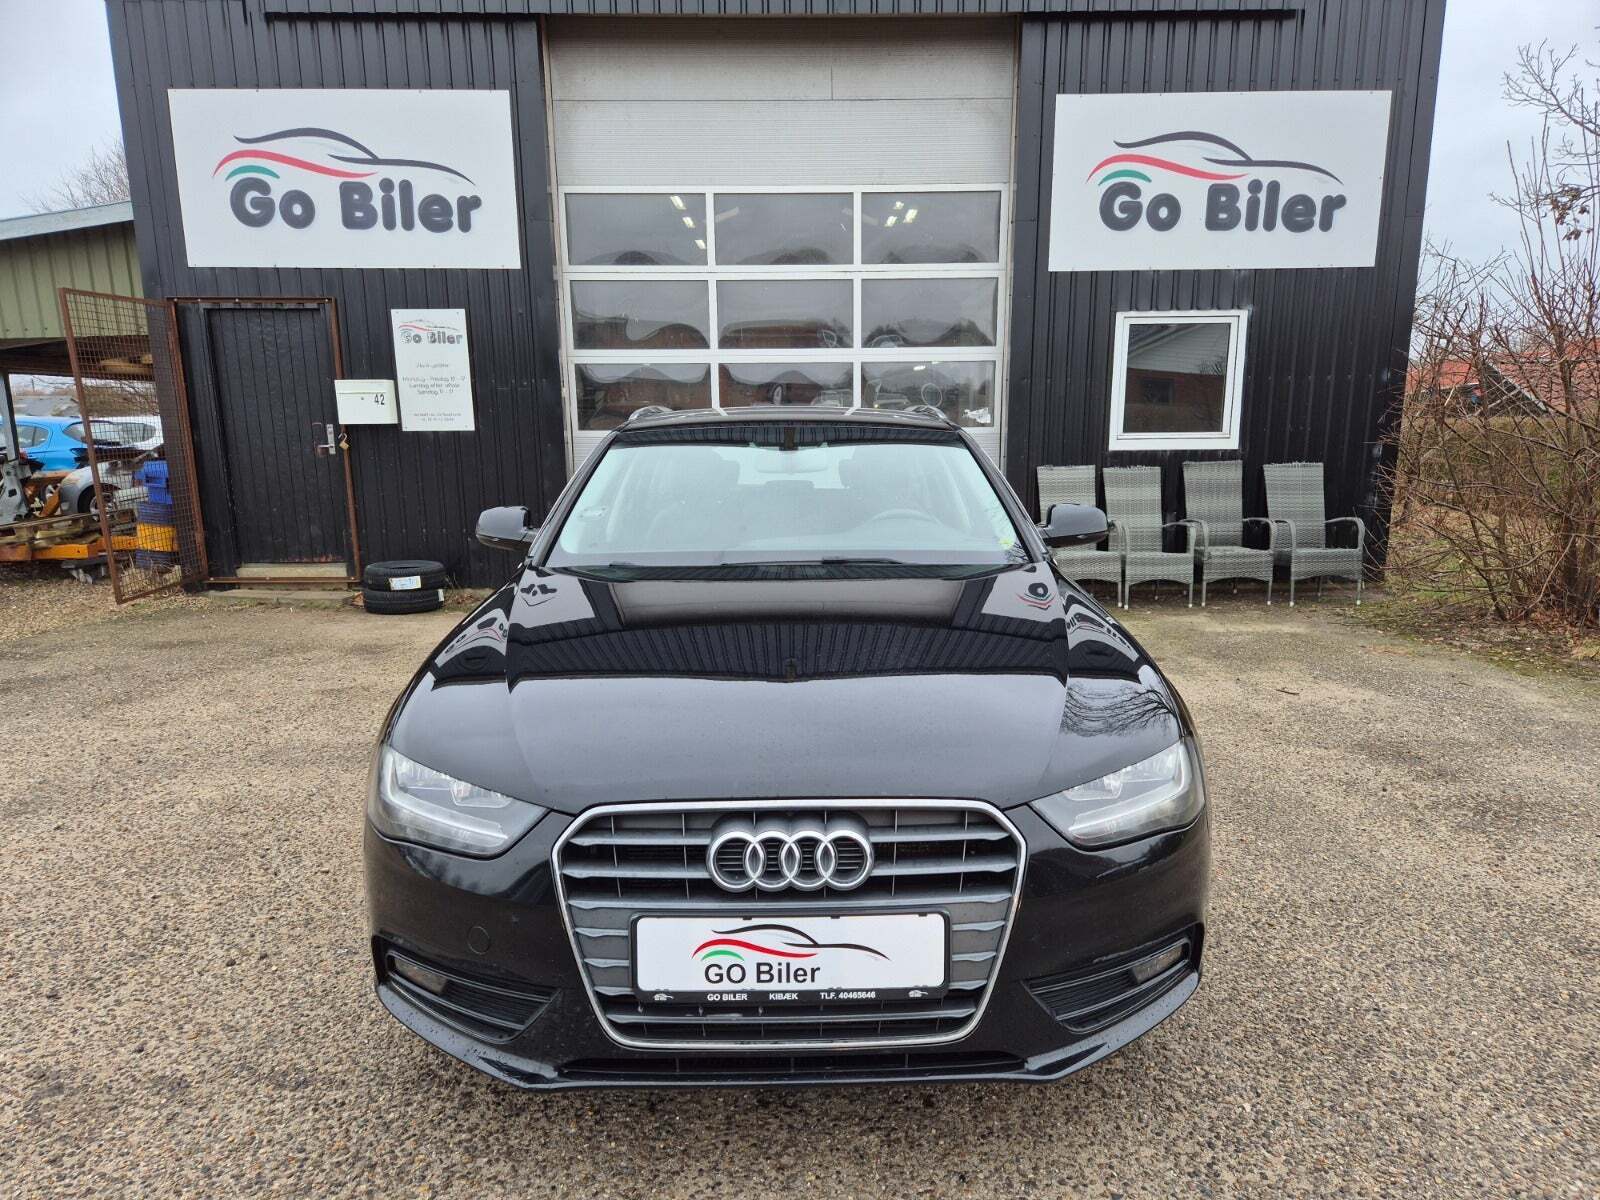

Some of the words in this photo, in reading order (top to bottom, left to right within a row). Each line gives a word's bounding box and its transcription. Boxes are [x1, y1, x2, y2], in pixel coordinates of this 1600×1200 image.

[230, 177, 315, 229] Go
[340, 179, 482, 233] Biler
[1099, 181, 1182, 232] Go
[1205, 179, 1347, 234] Biler
[427, 331, 463, 345] Biler
[374, 393, 385, 406] 42
[704, 963, 746, 984] GO
[756, 962, 821, 984] Biler
[707, 993, 721, 1001] GO
[722, 993, 748, 1001] BILER
[769, 992, 799, 1000] KIBÆK
[820, 992, 837, 1000] TLF.
